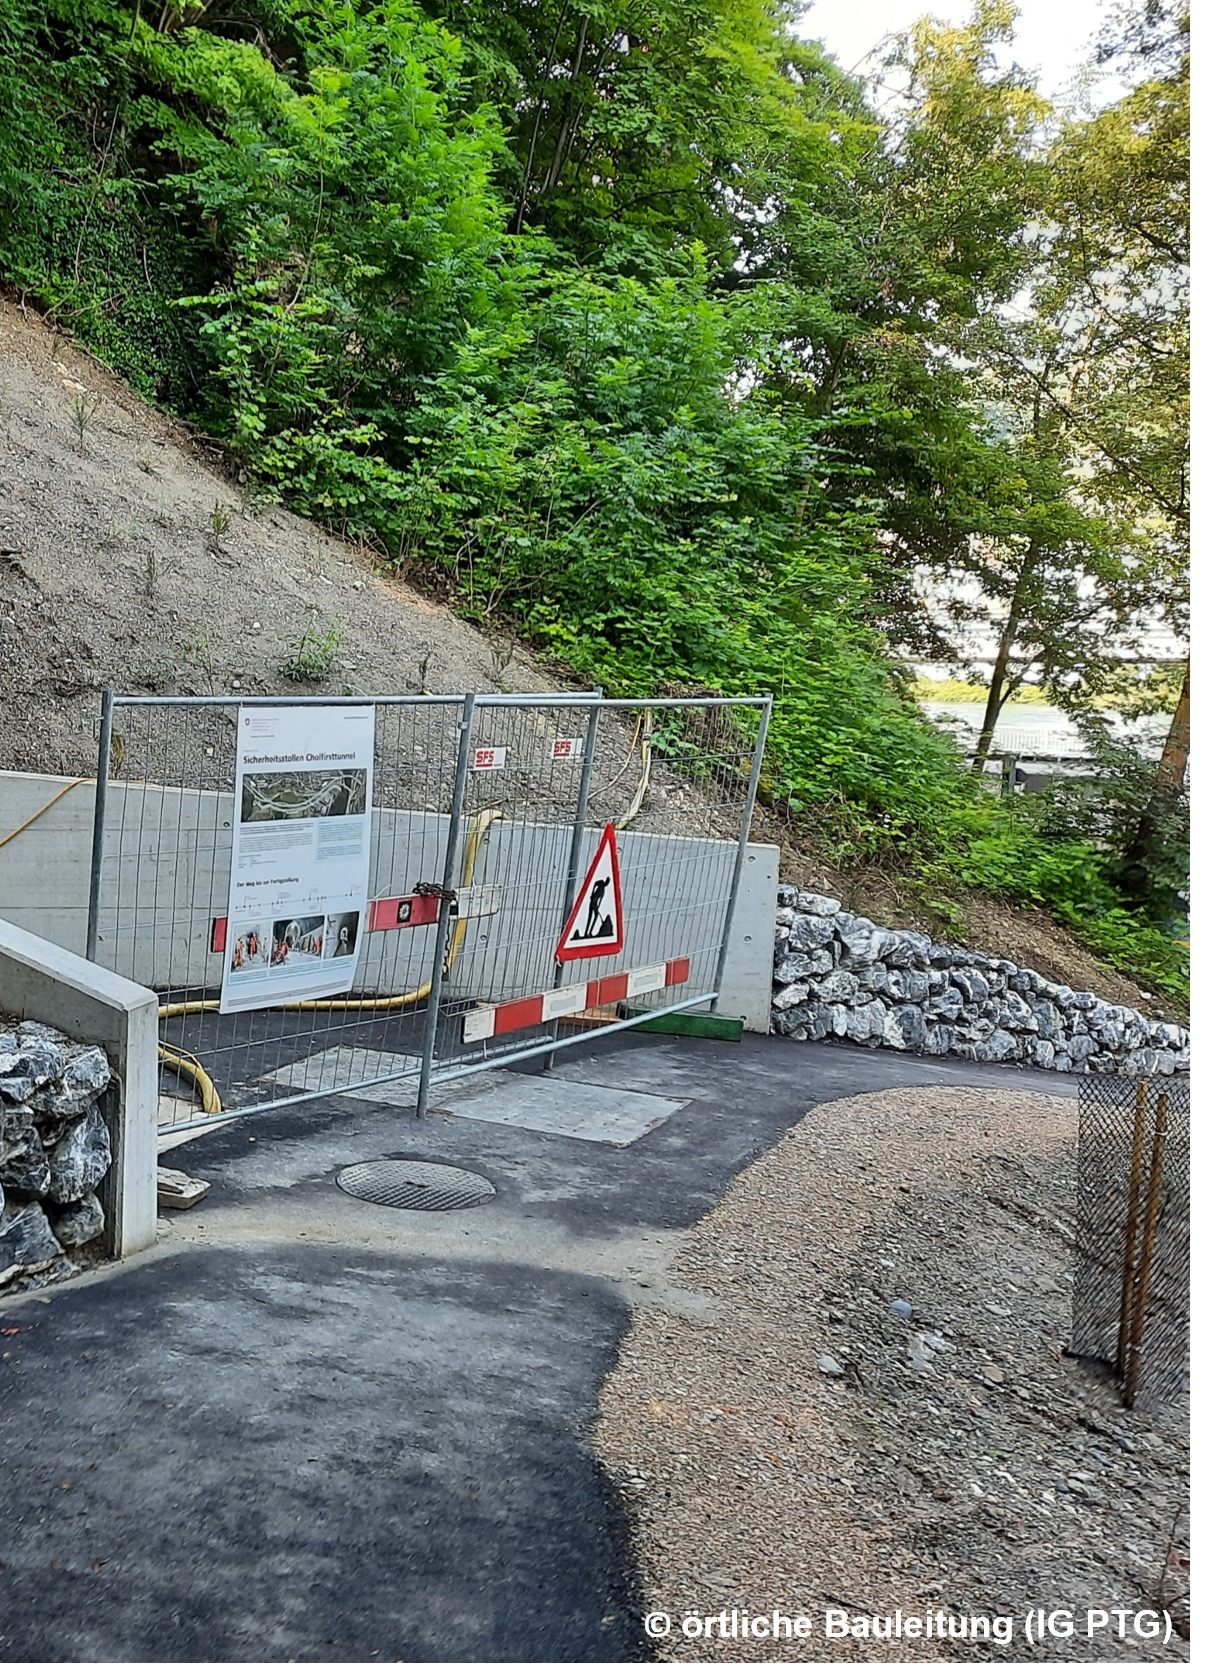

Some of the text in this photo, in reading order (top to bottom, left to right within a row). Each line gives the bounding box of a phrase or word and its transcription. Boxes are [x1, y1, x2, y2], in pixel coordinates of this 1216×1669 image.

[554, 741, 572, 753] SFS
[243, 751, 356, 764] Sicherheitsstollen Cholfirsttunnel
[476, 750, 495, 763] SFS
